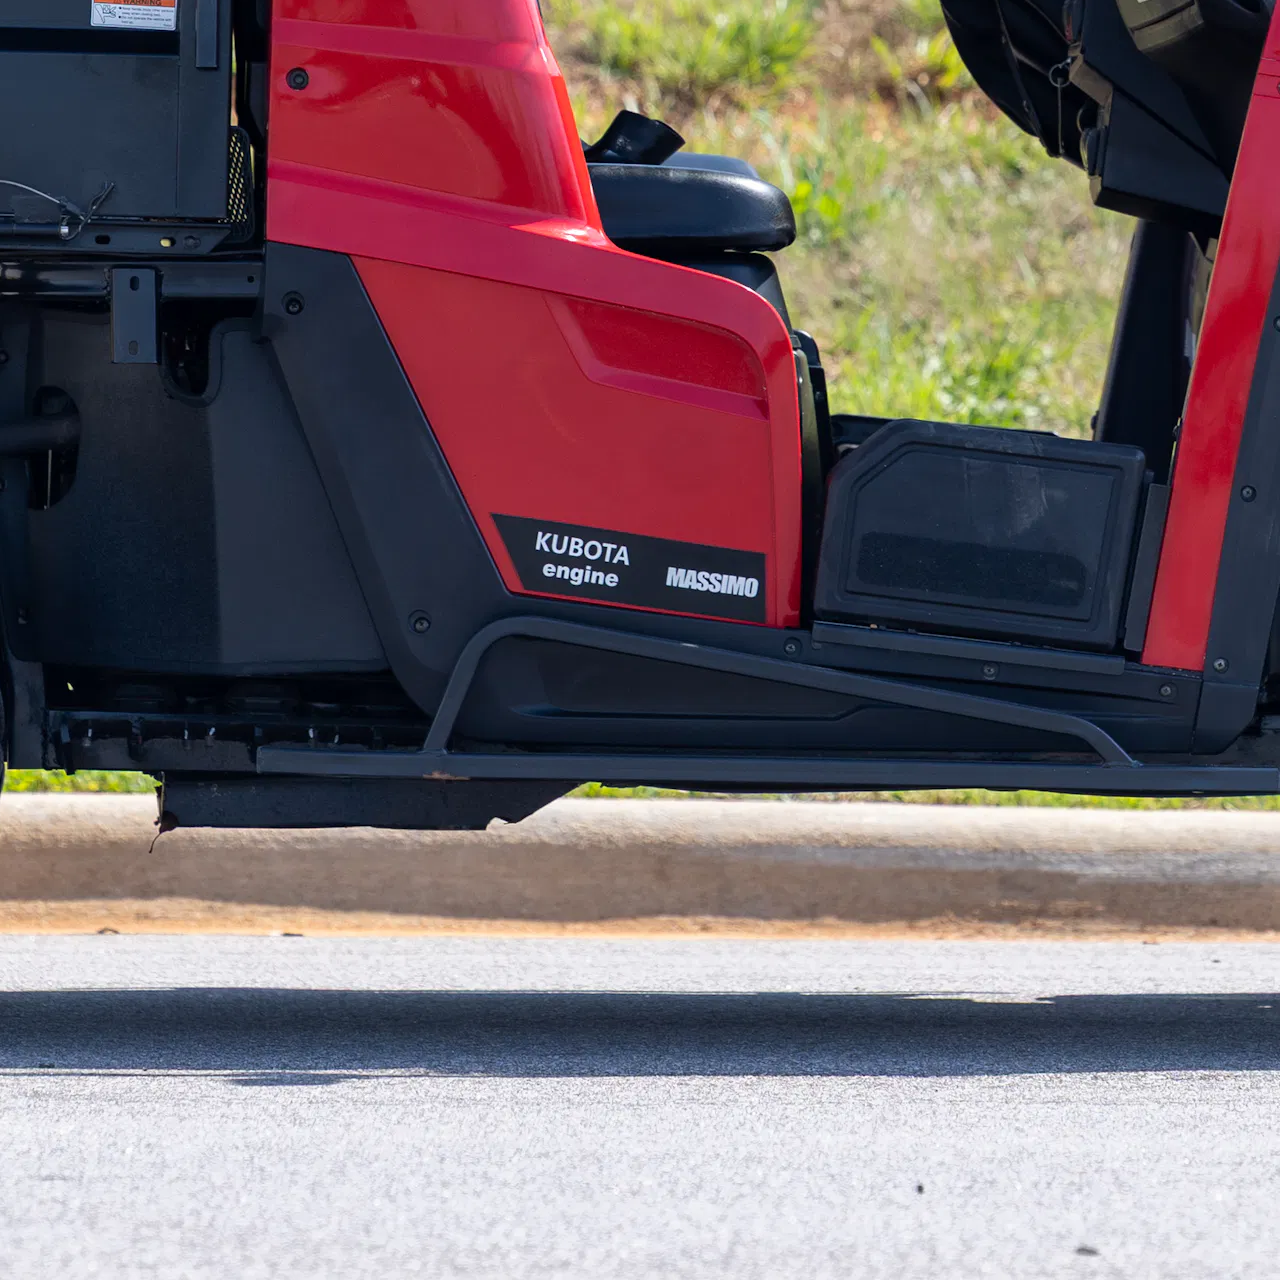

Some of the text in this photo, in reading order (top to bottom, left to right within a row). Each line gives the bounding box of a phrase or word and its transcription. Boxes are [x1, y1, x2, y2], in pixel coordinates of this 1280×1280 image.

[534, 530, 630, 566] KUBOTA
[542, 561, 620, 587] engine
[665, 566, 759, 598] MASSIMO
